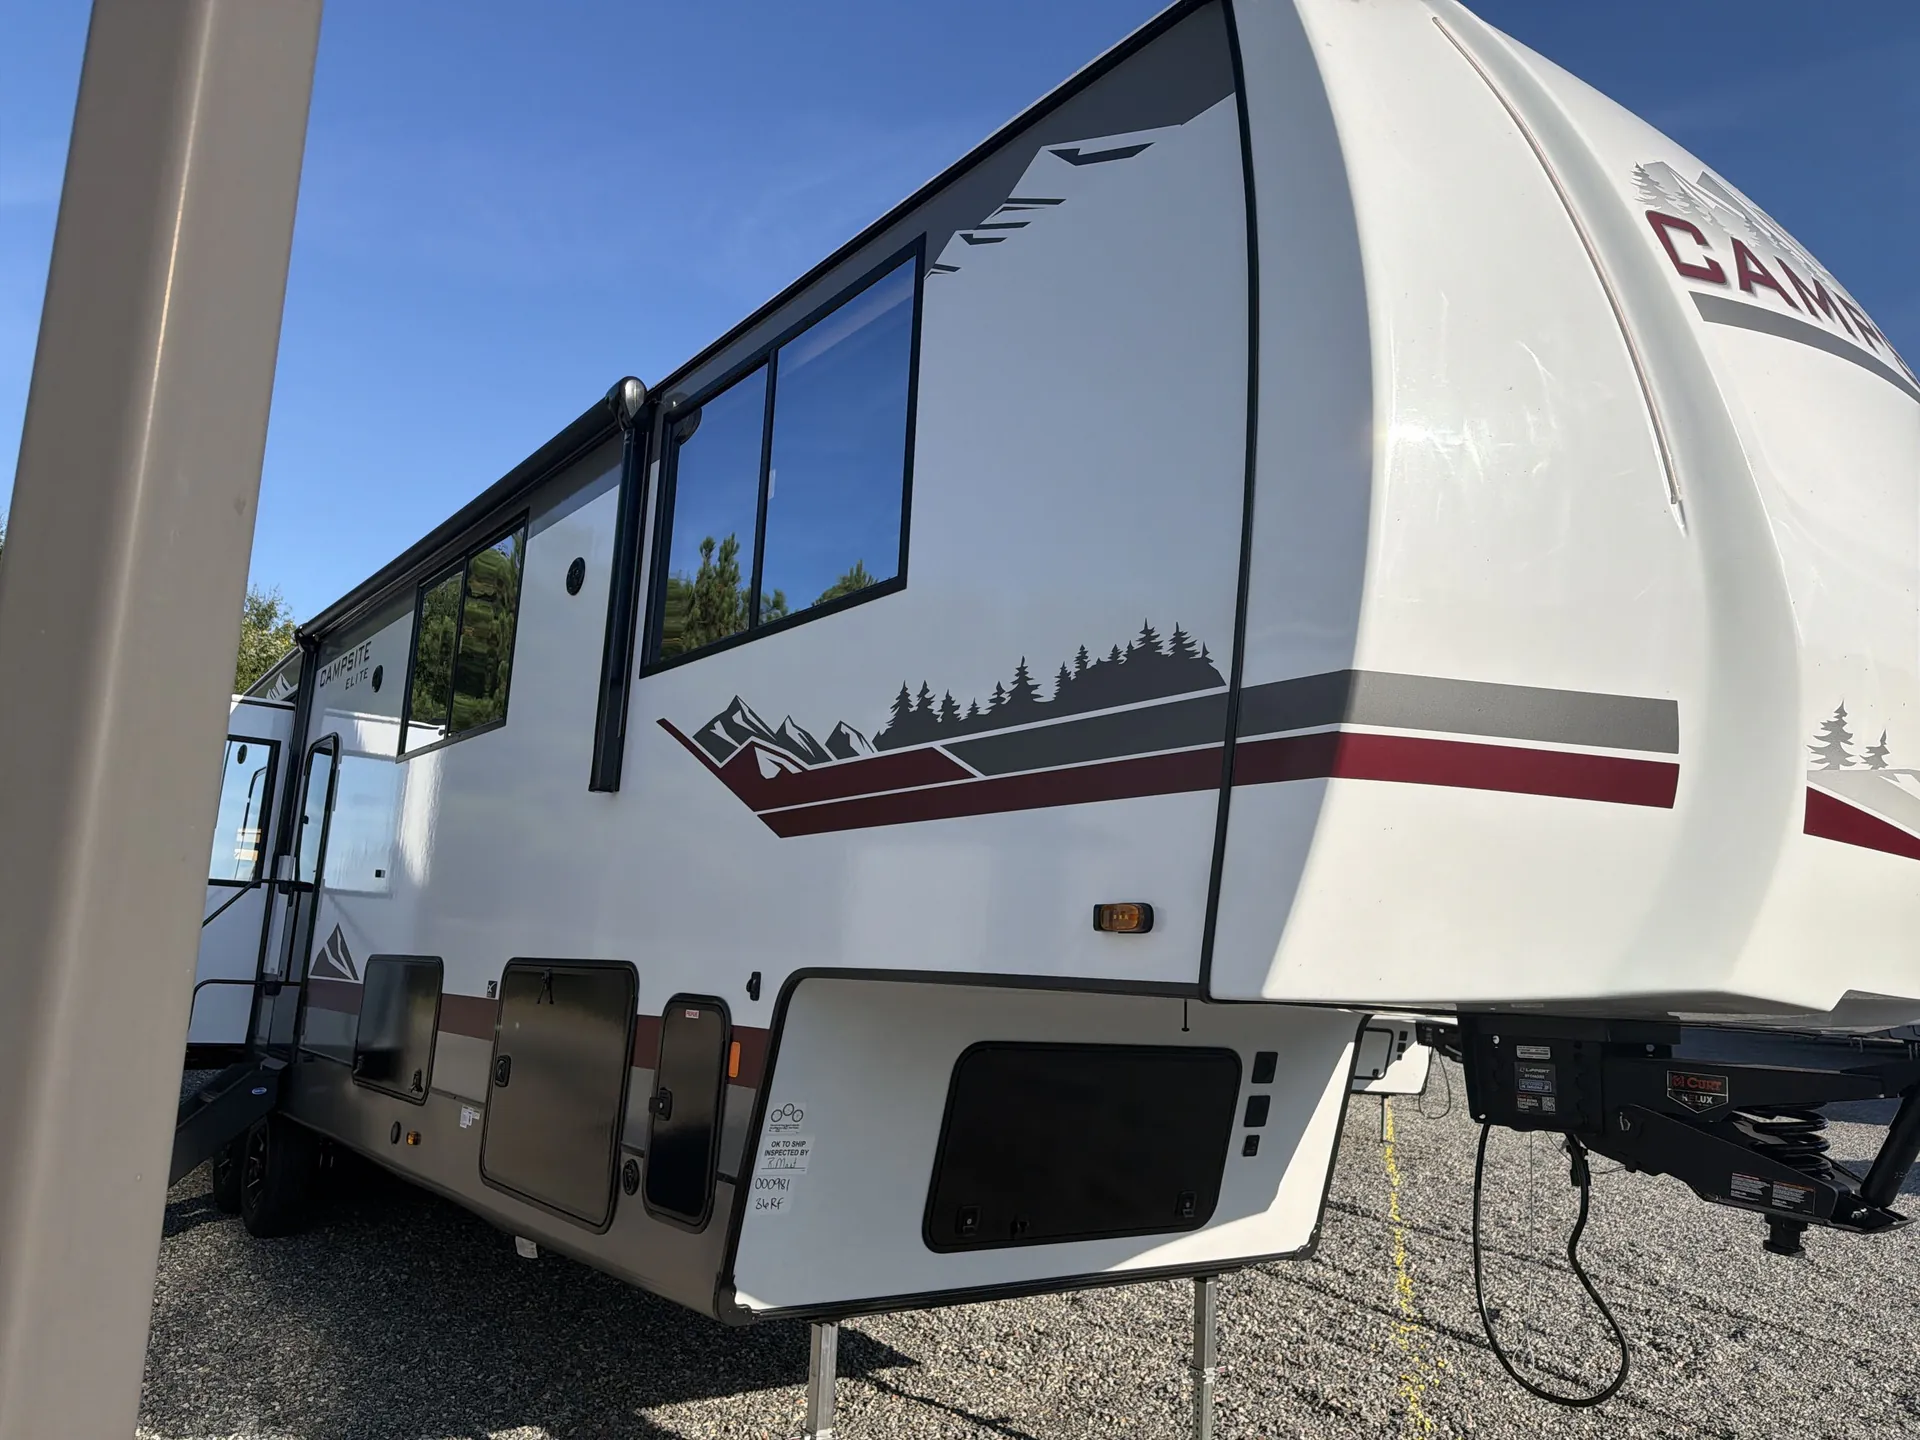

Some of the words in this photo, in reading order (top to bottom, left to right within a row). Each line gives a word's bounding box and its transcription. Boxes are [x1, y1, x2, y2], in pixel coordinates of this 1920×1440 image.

[320, 641, 372, 688] CAMPSITE
[345, 667, 369, 690] ELITE
[771, 1140, 782, 1148] OK
[782, 1140, 791, 1148] TO
[791, 1140, 807, 1148] SHIP
[764, 1149, 799, 1157] INSPECTED
[754, 1177, 791, 1192] 000981
